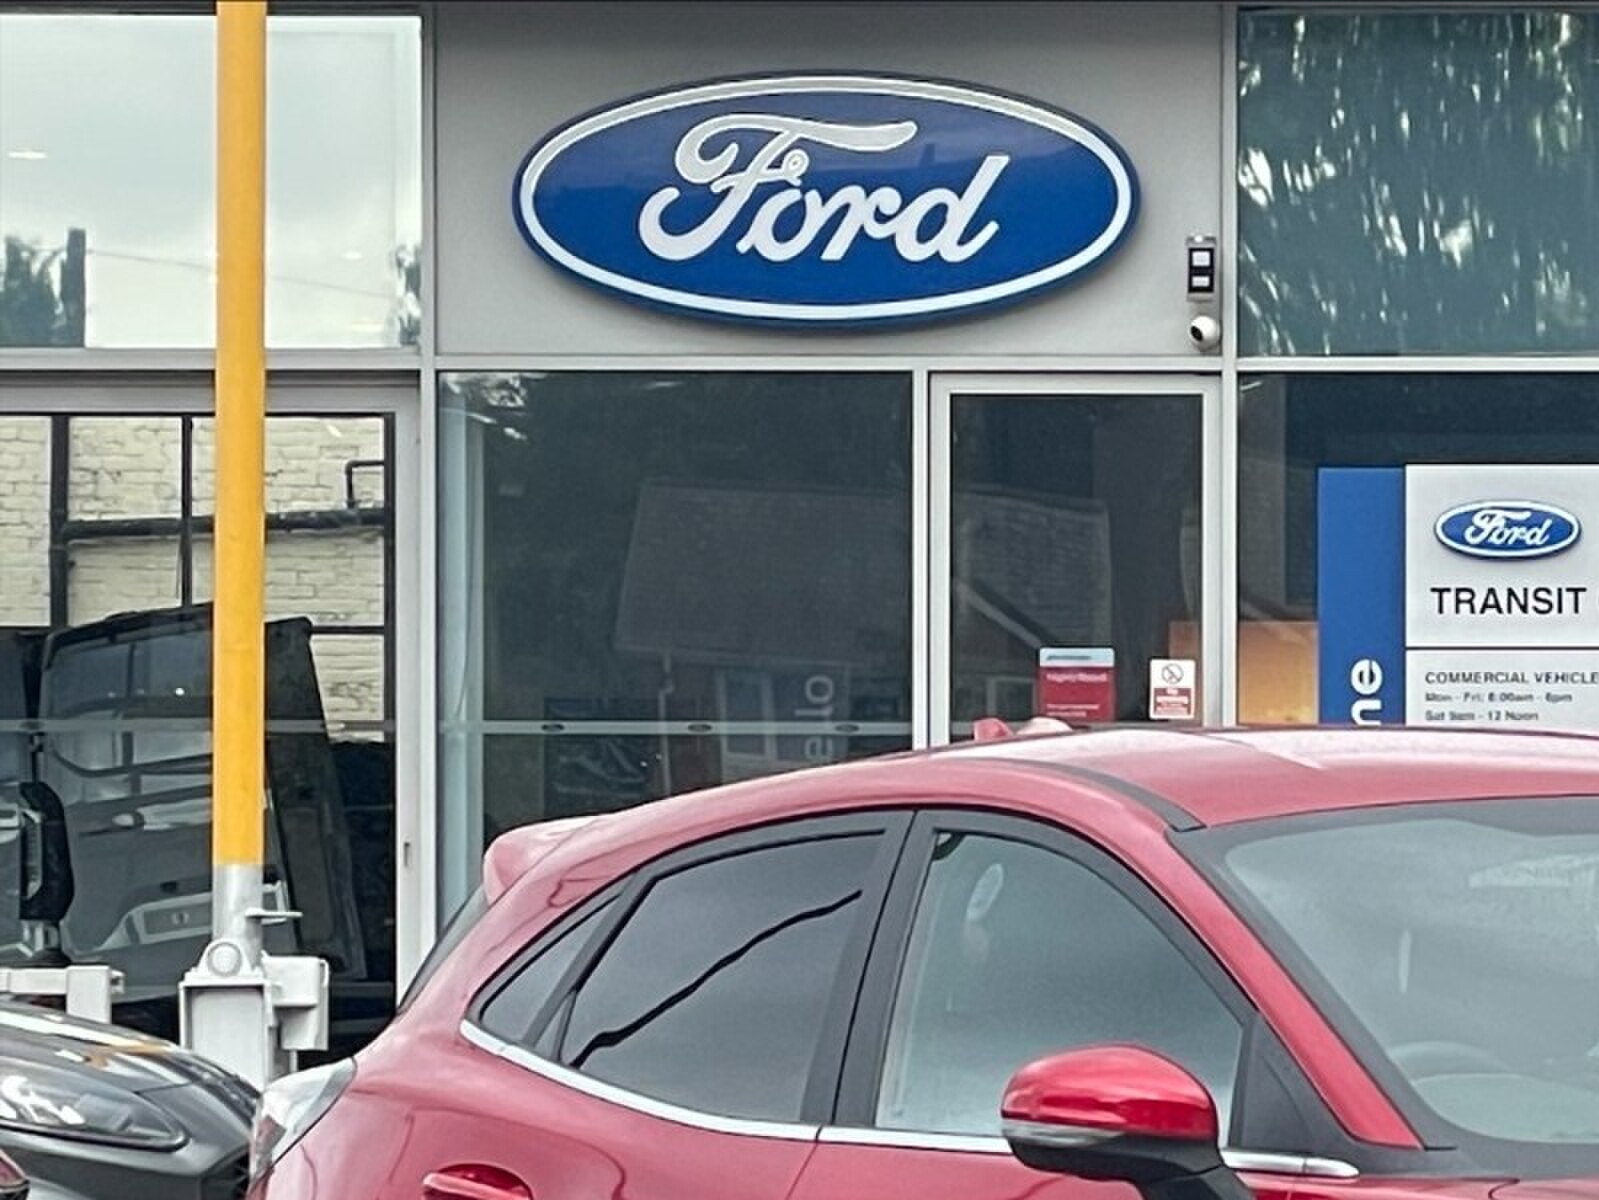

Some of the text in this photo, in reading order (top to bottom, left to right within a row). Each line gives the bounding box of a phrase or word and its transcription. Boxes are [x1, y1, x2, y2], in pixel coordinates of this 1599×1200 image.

[638, 112, 1011, 263] Ford
[1463, 507, 1554, 546] Ford
[1430, 586, 1588, 616] TRANSIT
[1424, 671, 1529, 685] COMMERCIAL
[1533, 671, 1599, 685] VEHICLE
[1425, 691, 1453, 702] Mon
[1425, 709, 1446, 721] Sat
[1487, 709, 1502, 721] 12
[1505, 709, 1540, 721] Noon
